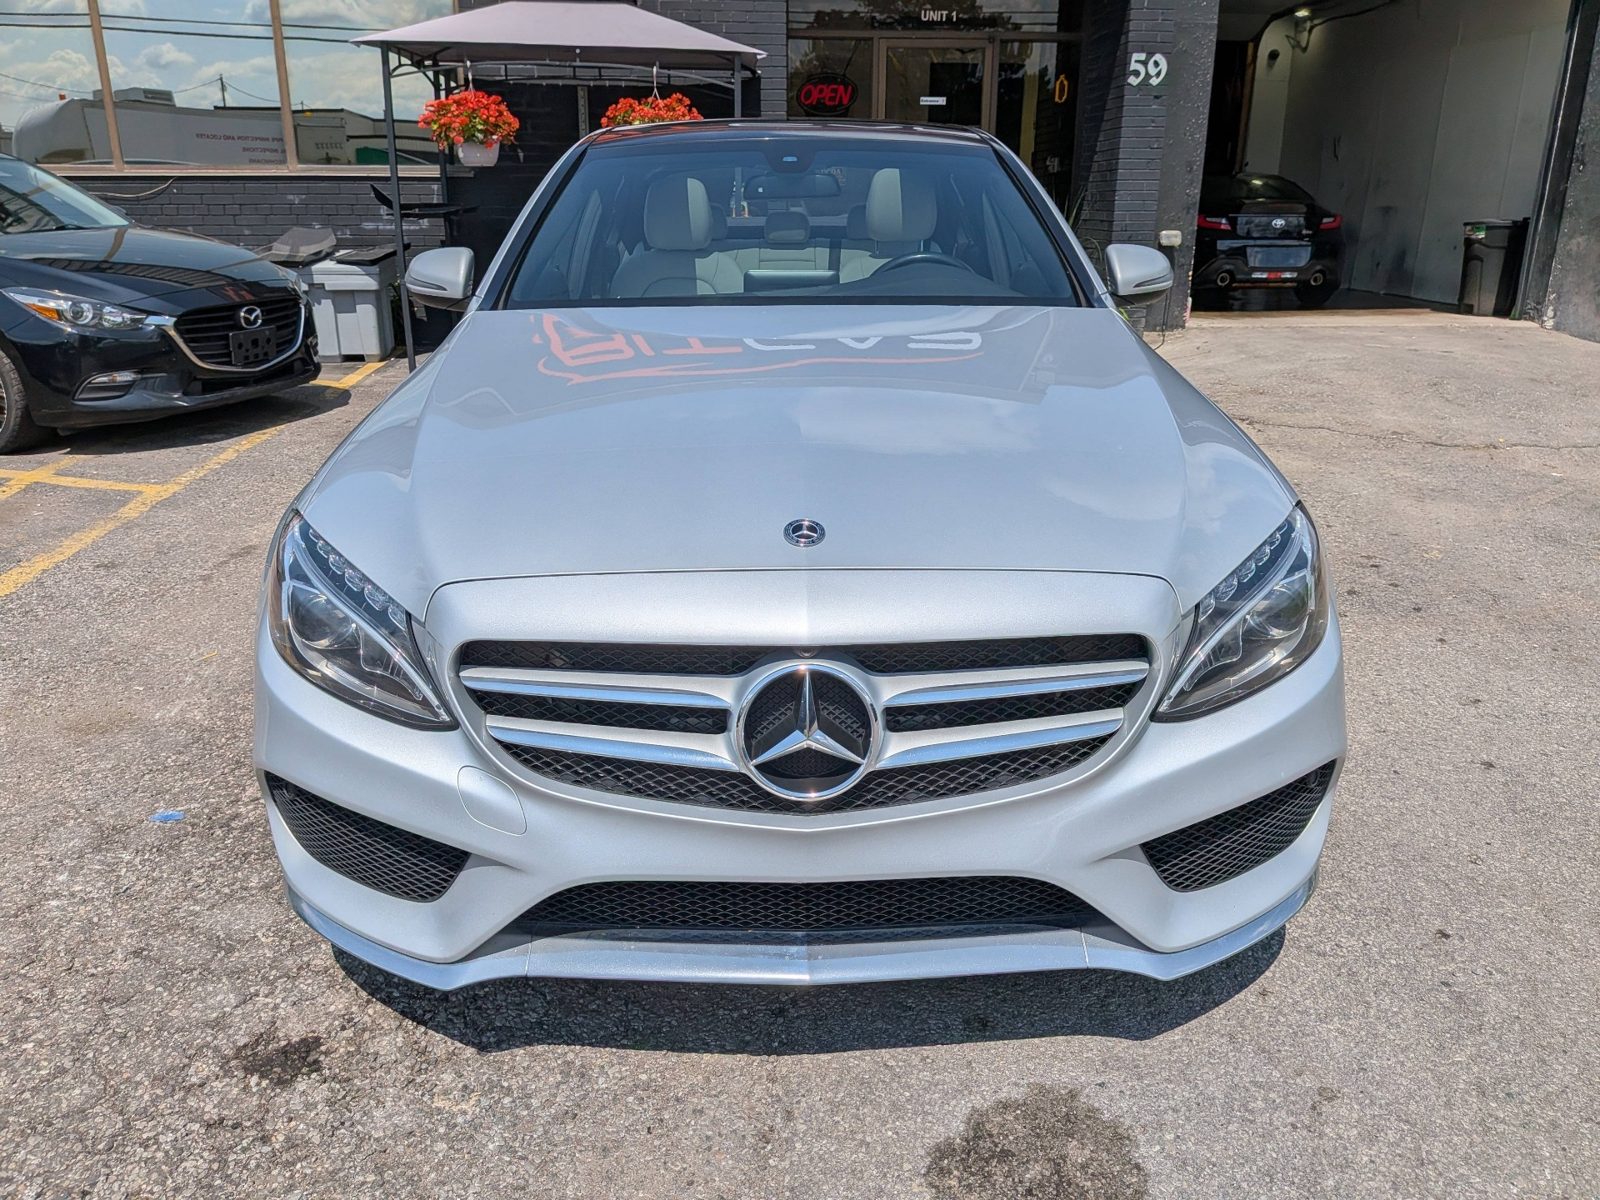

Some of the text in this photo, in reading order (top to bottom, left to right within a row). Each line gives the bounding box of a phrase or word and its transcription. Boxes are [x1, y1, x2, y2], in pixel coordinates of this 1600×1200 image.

[921, 10, 957, 22] UNIT 1
[1127, 52, 1168, 86] 59
[800, 84, 852, 105] OPEN
